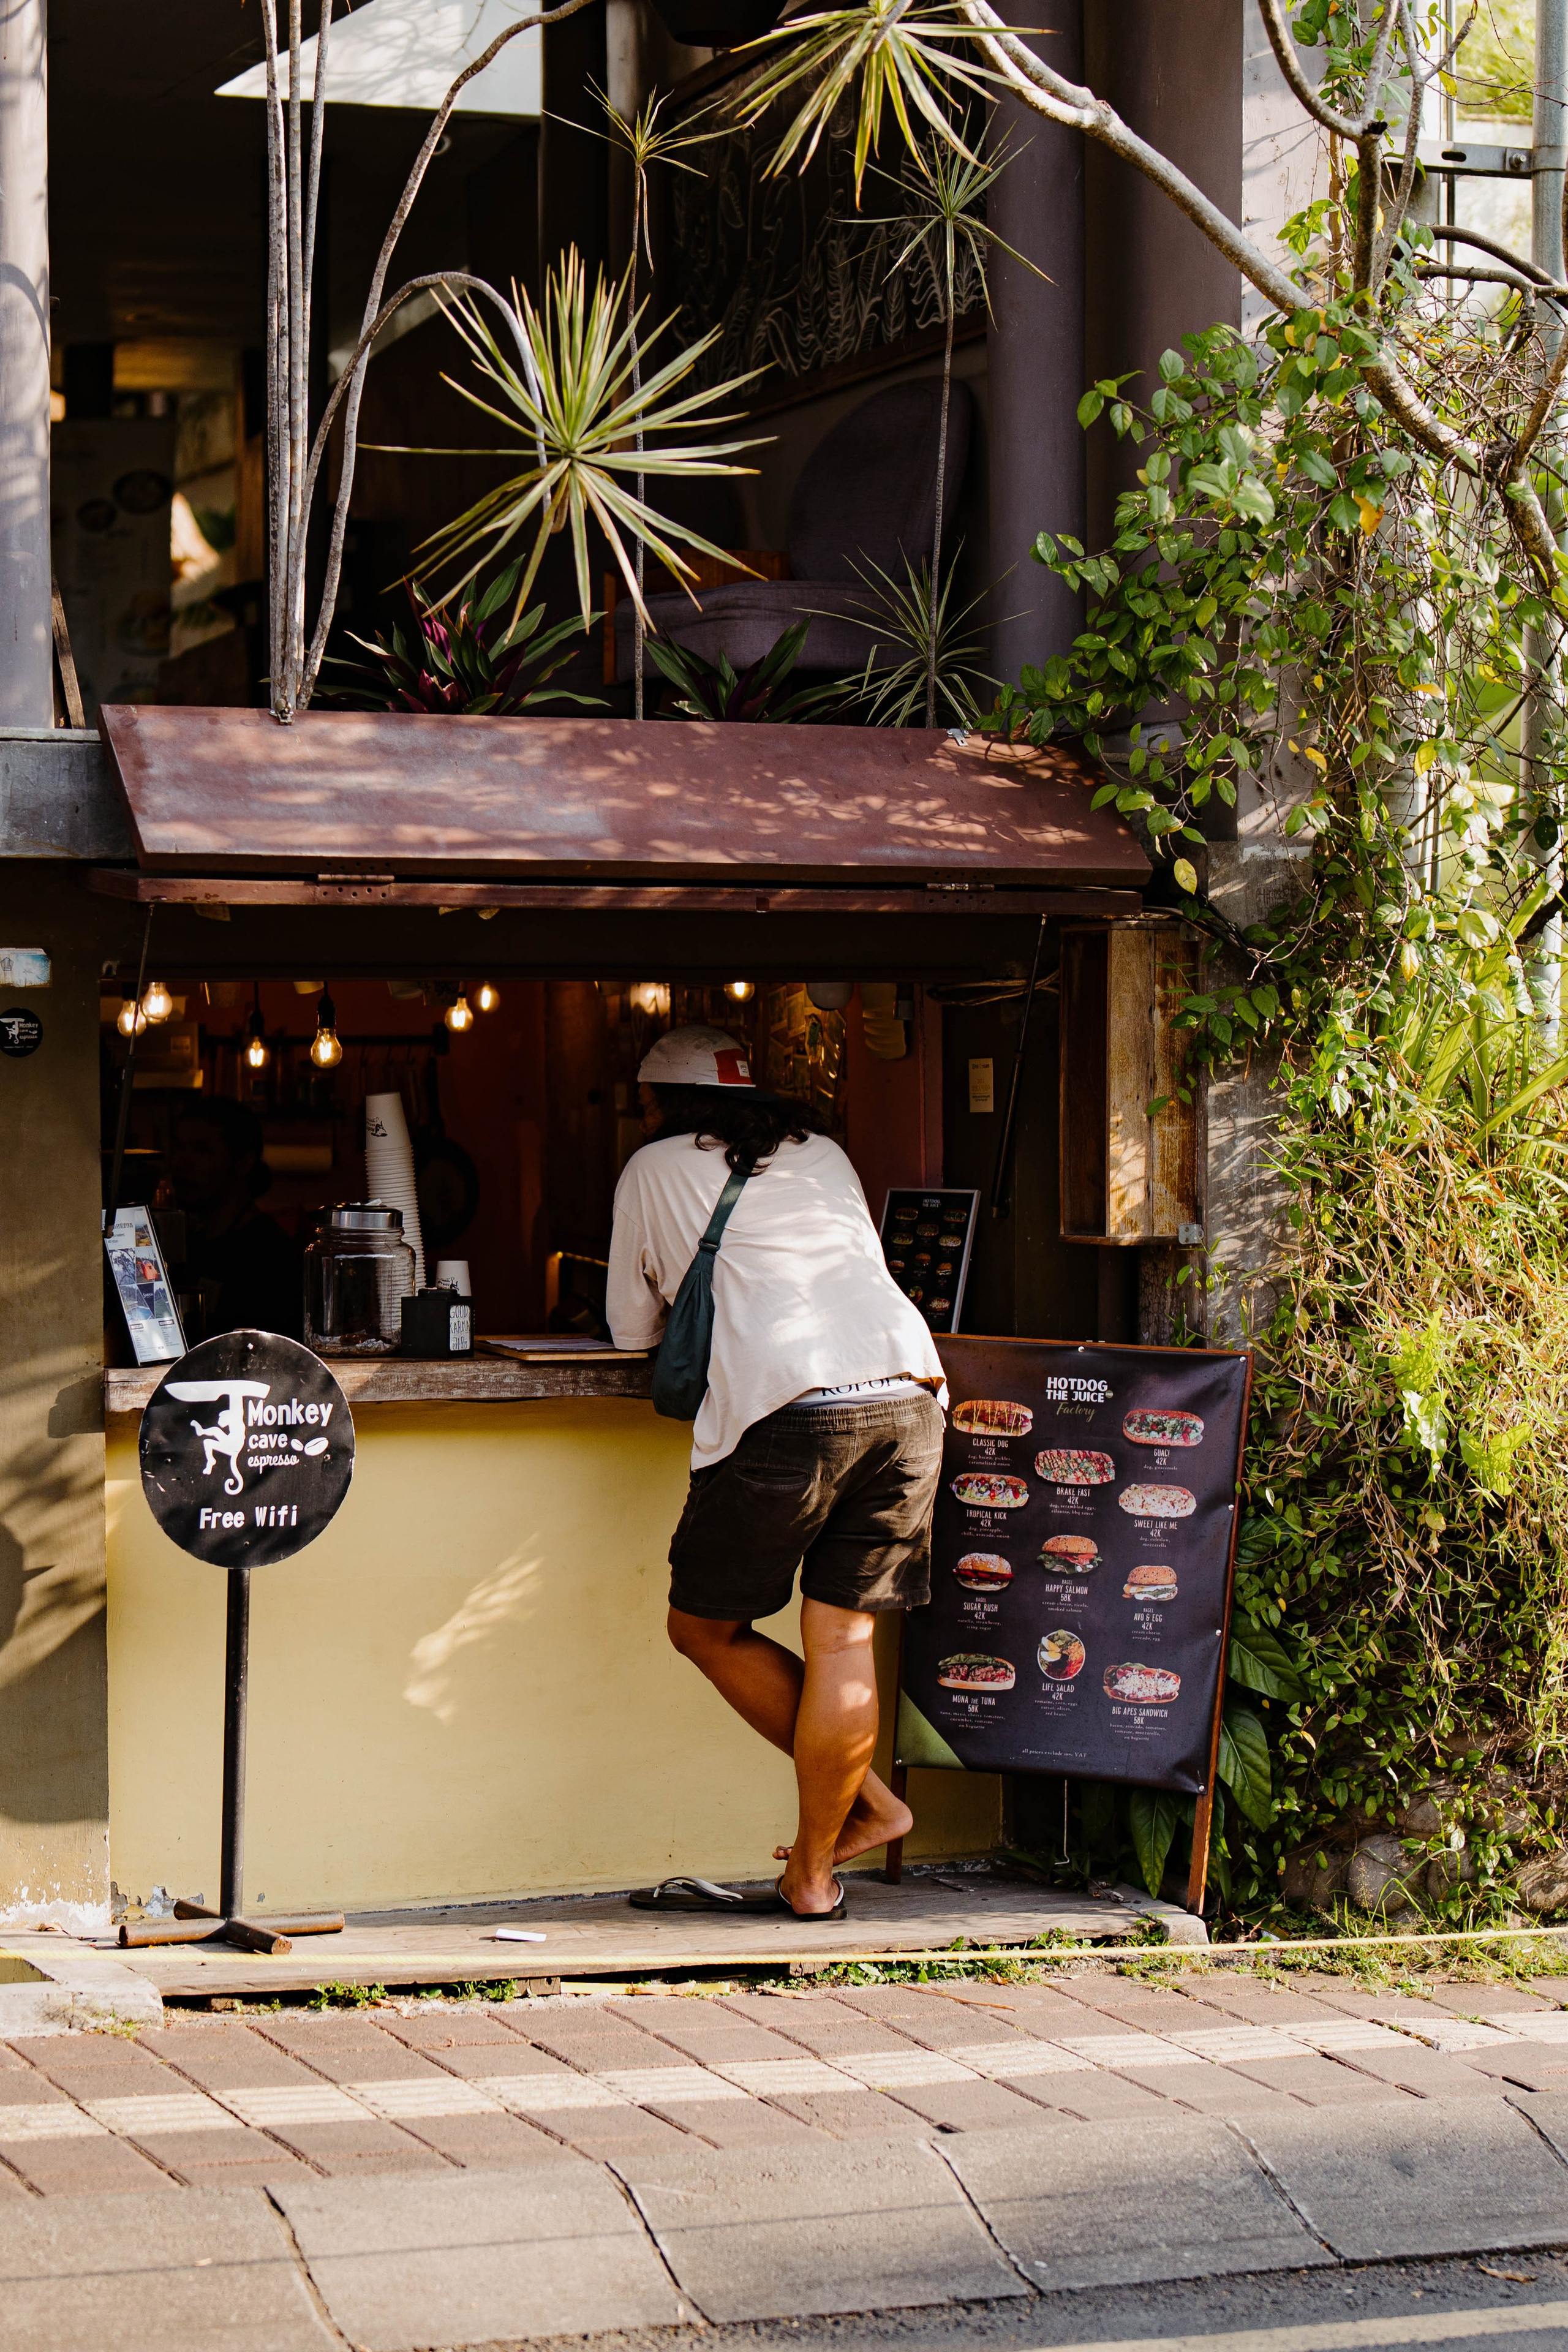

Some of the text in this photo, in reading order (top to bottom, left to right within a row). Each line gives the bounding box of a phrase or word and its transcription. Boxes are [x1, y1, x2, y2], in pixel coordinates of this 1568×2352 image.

[450, 1305, 469, 1319] GOOD
[1047, 1377, 1108, 1392] HOTDOG
[1046, 1389, 1104, 1403] THE JUICE
[248, 1398, 333, 1427] Monkey
[1056, 1401, 1097, 1422] Factory
[249, 1433, 288, 1449] cave
[973, 1438, 995, 1447] CLASSIC
[247, 1454, 300, 1474] espresso
[1057, 1487, 1090, 1497] BRAKE FAST
[200, 1505, 298, 1529] Free Wifi
[967, 1509, 992, 1519] TROPICAL
[1134, 1519, 1153, 1528] SWEET
[1155, 1520, 1167, 1529] LIKE
[1150, 1529, 1161, 1537] 42K
[1046, 1584, 1088, 1594] HAPPY SALMON
[963, 1602, 998, 1612] SUGAR RUSH
[1152, 1613, 1163, 1622] EGG
[1042, 1683, 1054, 1691] LIFE
[952, 1694, 968, 1703] MONA
[981, 1697, 995, 1706] TUNA
[1123, 1707, 1137, 1716] APES
[1139, 1708, 1168, 1717] SANDWICH
[1134, 1716, 1144, 1725] 58K
